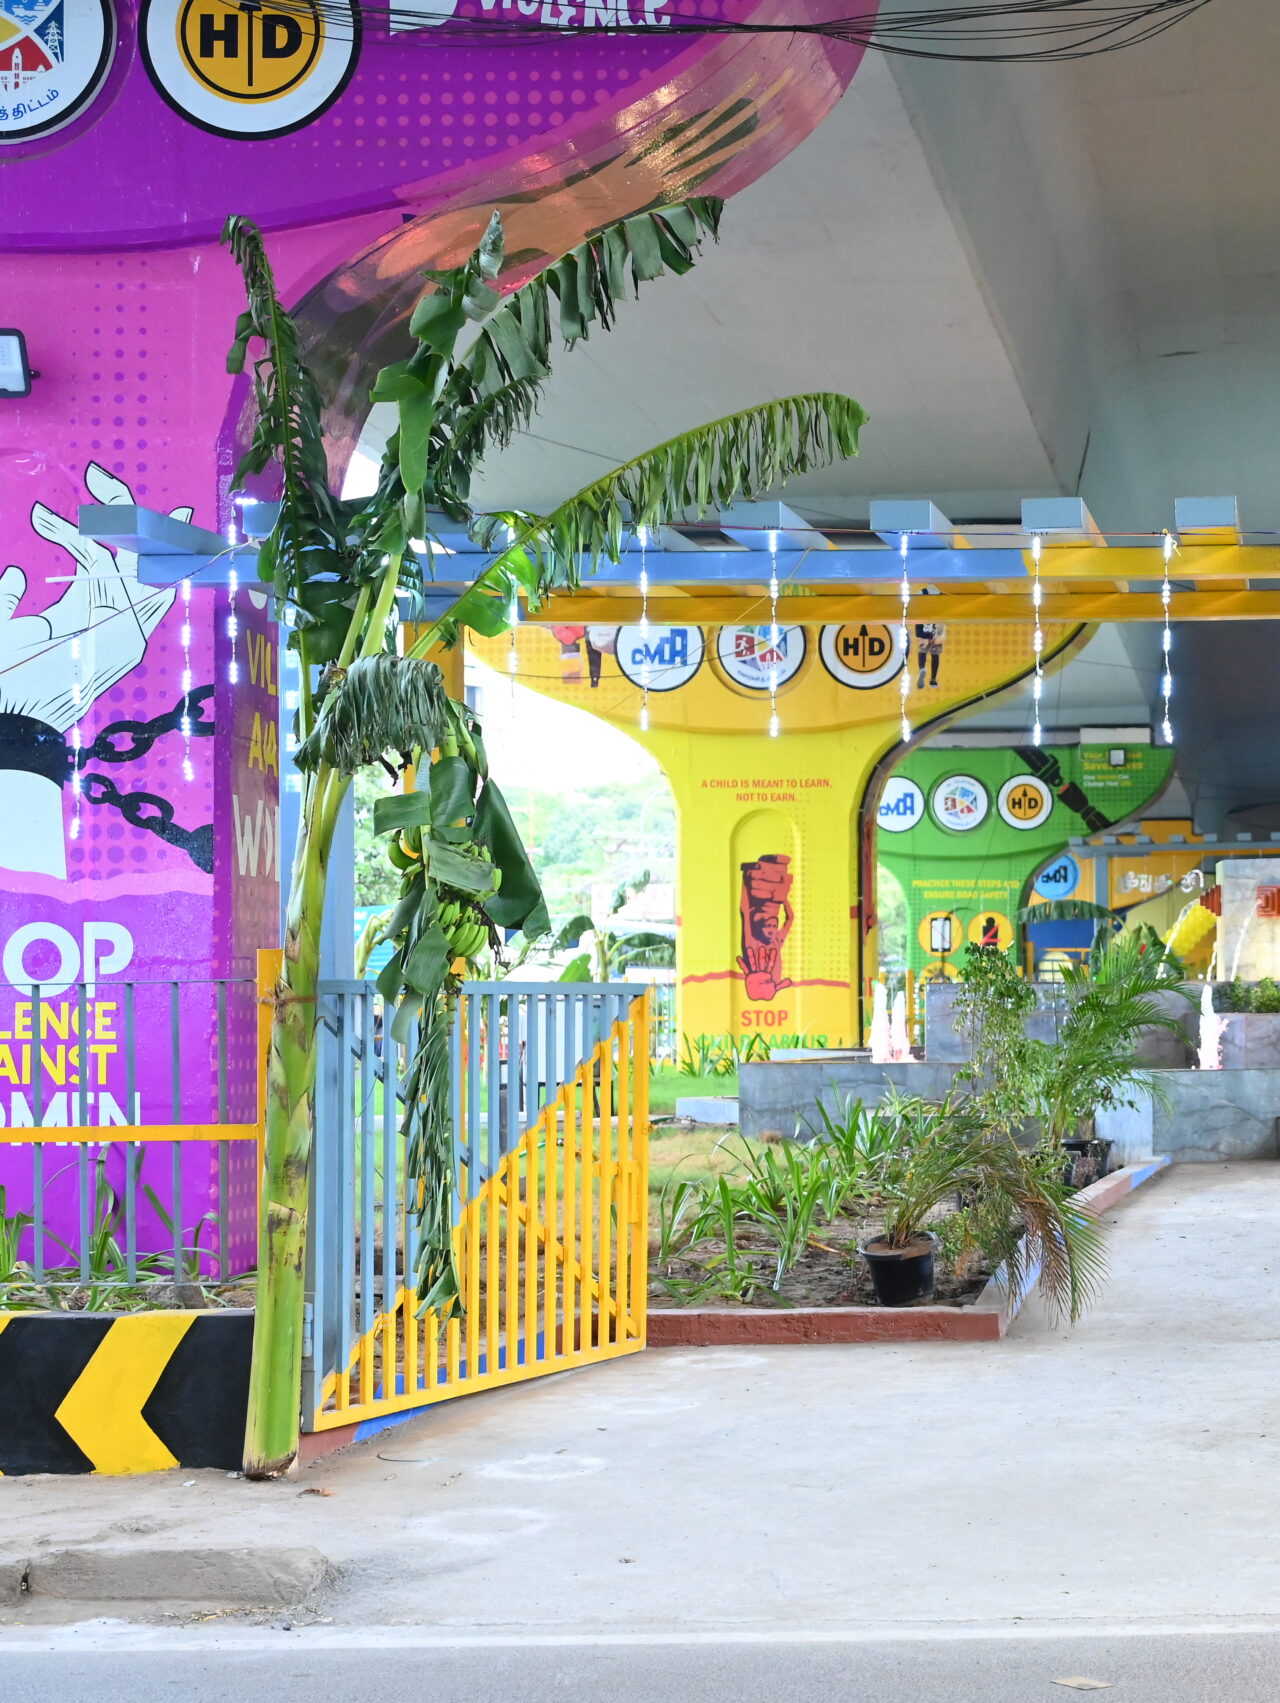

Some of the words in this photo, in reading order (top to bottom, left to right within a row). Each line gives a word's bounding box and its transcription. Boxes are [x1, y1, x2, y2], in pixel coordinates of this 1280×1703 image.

[701, 780, 708, 788] A
[710, 780, 738, 788] CHILD
[741, 780, 750, 788] IS
[752, 779, 784, 788] MEANT
[786, 779, 797, 788] TO
[736, 793, 755, 802] NOT
[757, 793, 768, 802] TO
[741, 1010, 788, 1027] STOP
